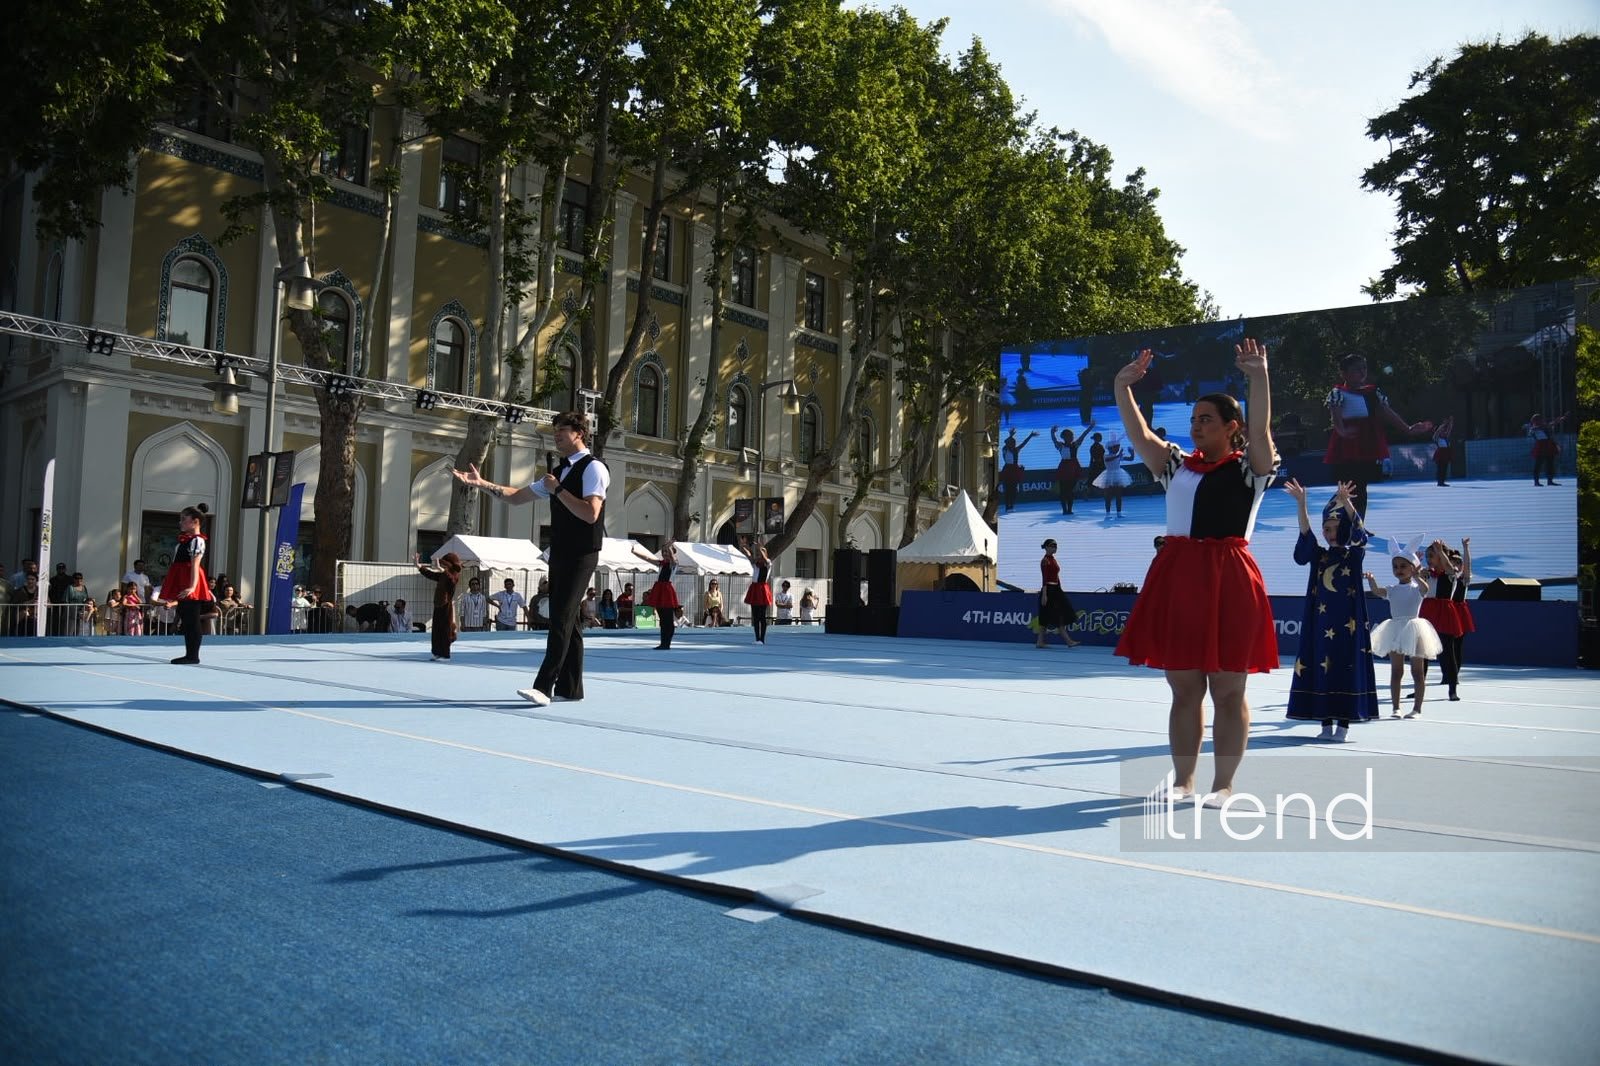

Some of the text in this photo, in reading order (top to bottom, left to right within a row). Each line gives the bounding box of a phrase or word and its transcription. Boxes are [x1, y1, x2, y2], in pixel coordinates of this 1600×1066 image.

[1021, 481, 1052, 493] BAKU
[962, 610, 991, 624] 4TH
[993, 611, 1032, 626] BAKU
[1089, 611, 1131, 632] FOR
